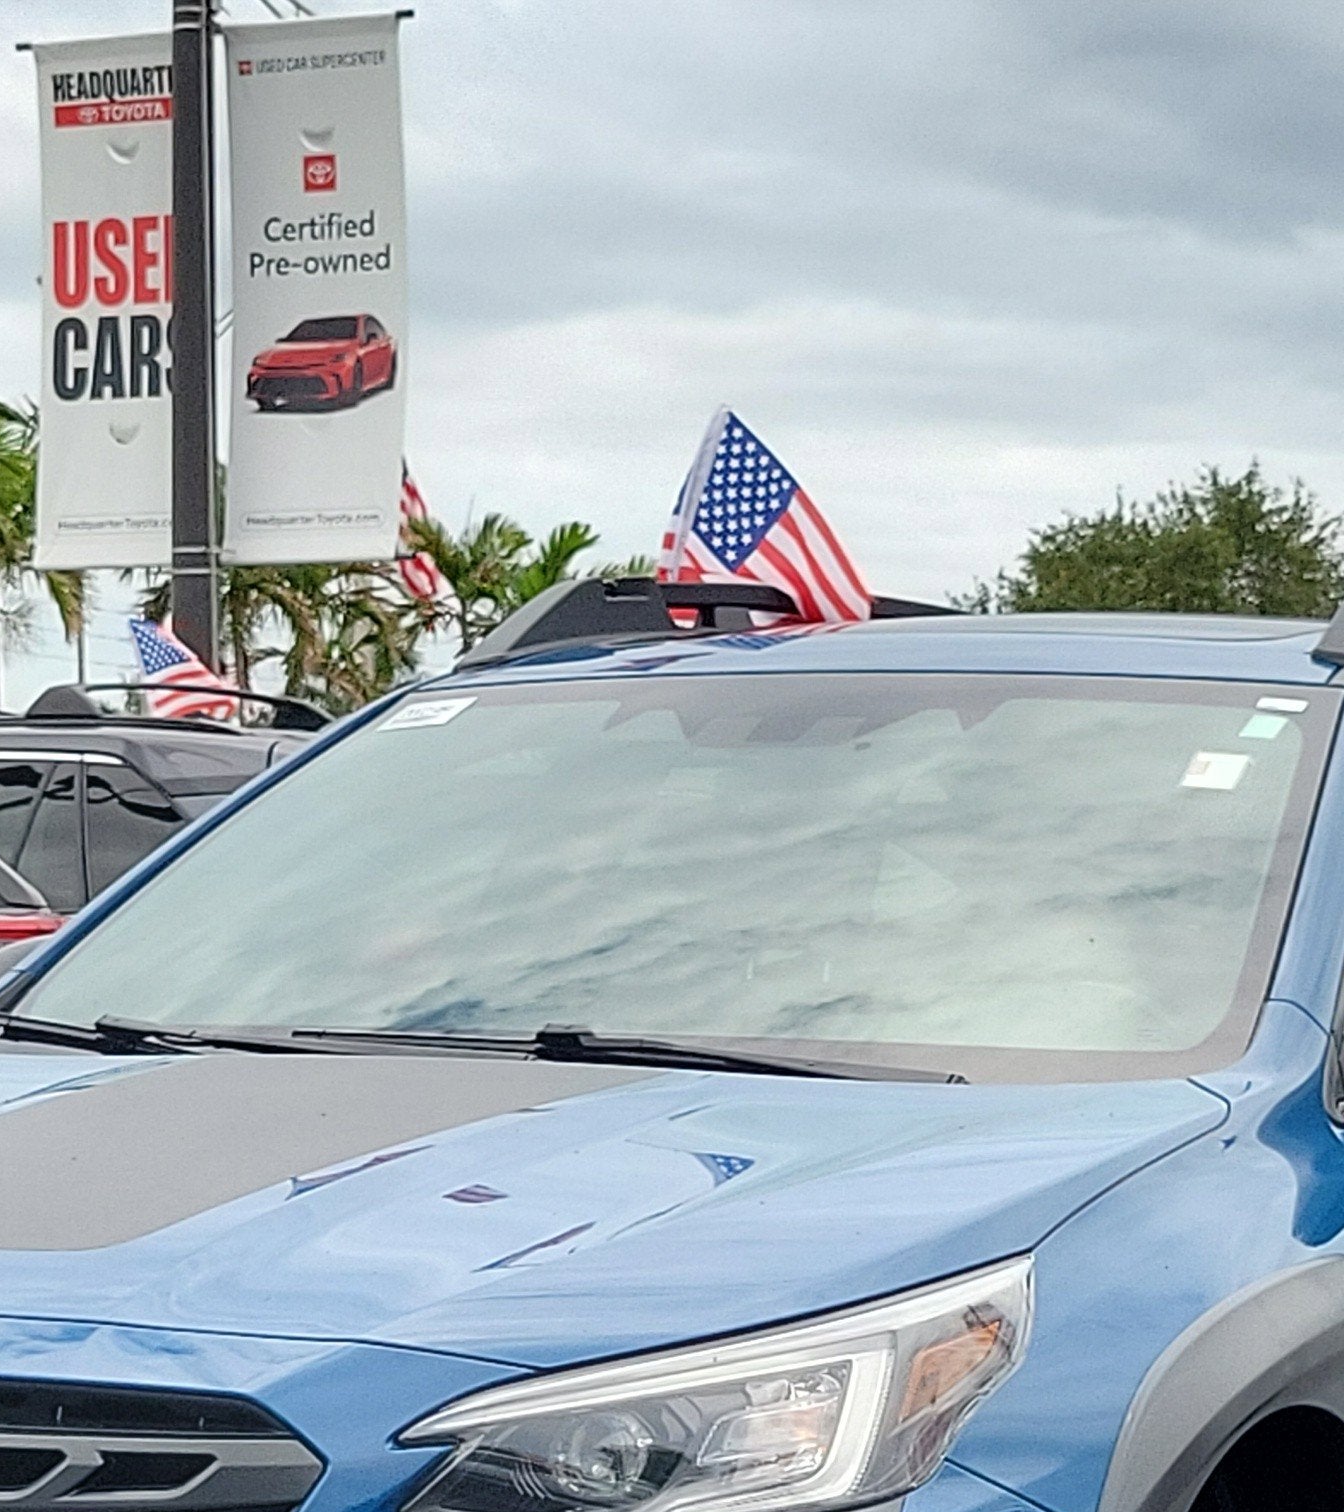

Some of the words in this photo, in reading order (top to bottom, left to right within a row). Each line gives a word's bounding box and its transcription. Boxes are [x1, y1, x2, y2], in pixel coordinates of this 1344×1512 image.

[52, 65, 172, 103] HEADQUART
[101, 104, 167, 122] TOYOTA
[264, 210, 375, 242] Certified
[53, 214, 172, 309] USE
[250, 245, 391, 277] Pre-owned
[52, 314, 172, 401] CAR
